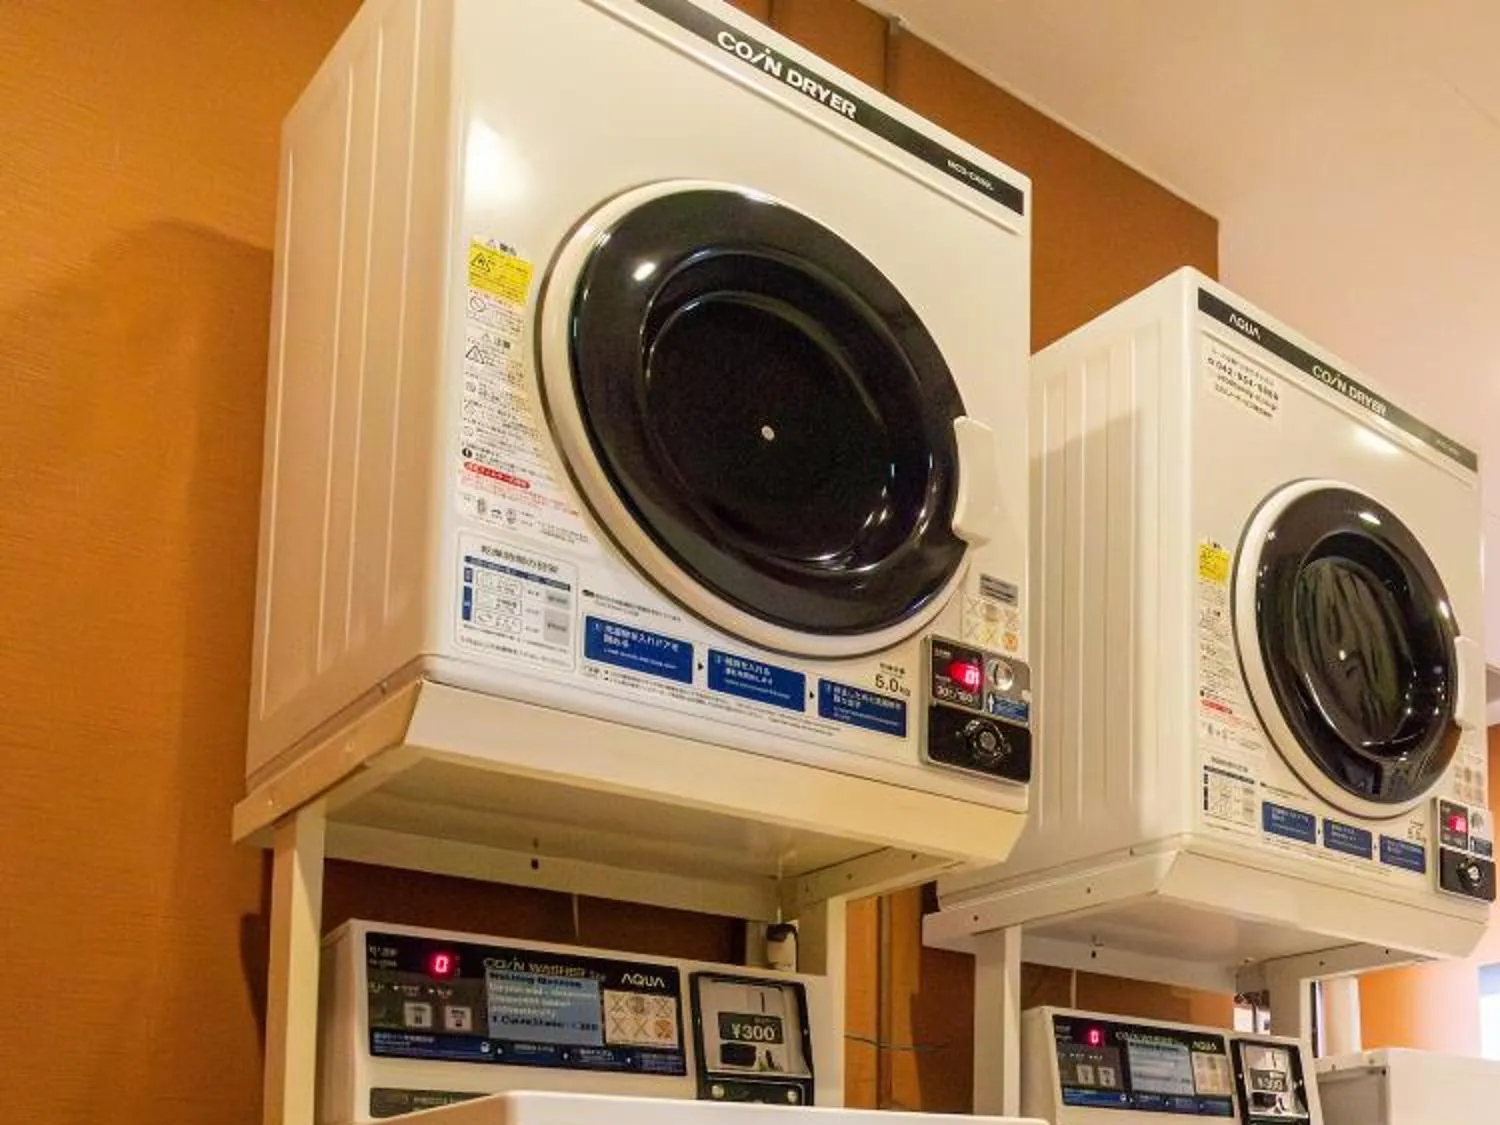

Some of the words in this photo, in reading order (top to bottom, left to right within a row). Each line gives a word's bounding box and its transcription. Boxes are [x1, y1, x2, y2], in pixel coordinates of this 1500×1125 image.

[786, 68, 857, 119] DRYER
[1228, 313, 1261, 340] AQUA
[1349, 386, 1387, 417] DRYER
[435, 955, 449, 973] 0
[621, 972, 665, 988] AQUA
[732, 1023, 775, 1041] ¥300
[1091, 1030, 1099, 1044] 0
